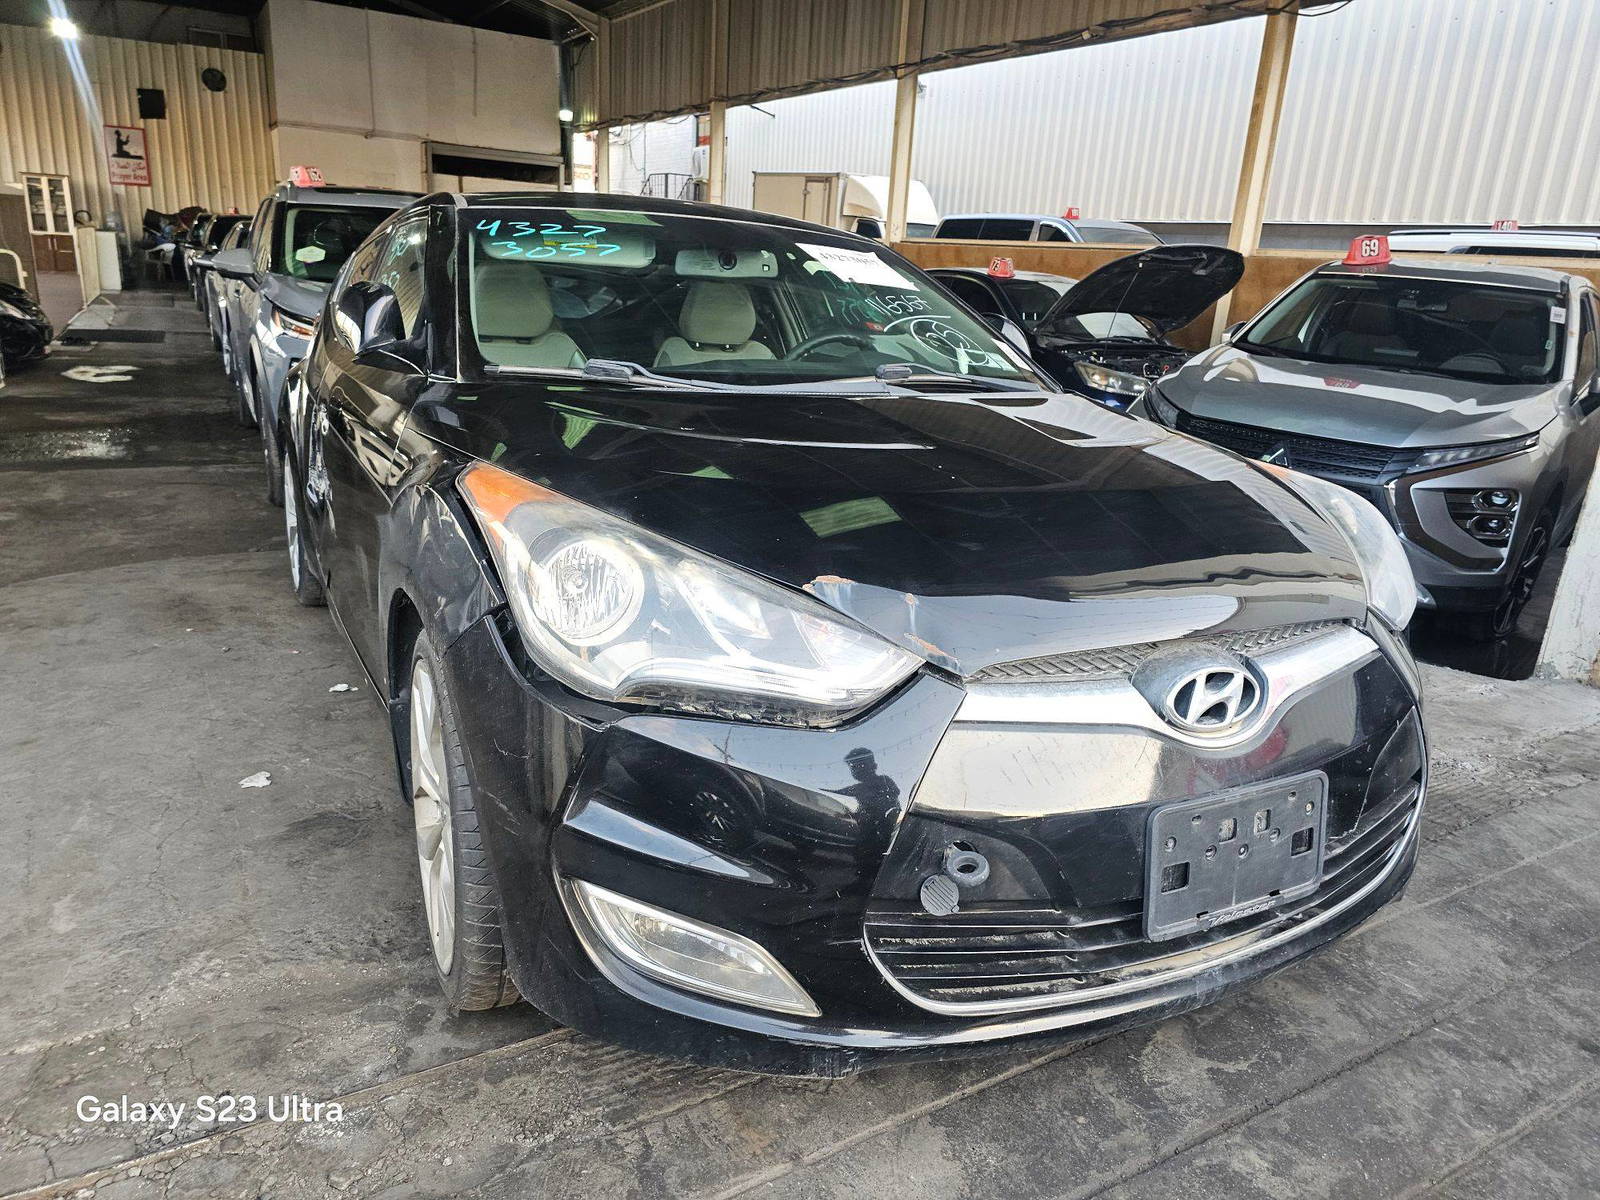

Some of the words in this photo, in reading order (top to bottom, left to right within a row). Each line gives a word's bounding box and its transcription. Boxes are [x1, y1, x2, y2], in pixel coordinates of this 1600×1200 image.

[476, 219, 607, 237] 4327
[491, 240, 621, 258] 3057
[1361, 239, 1379, 257] 69
